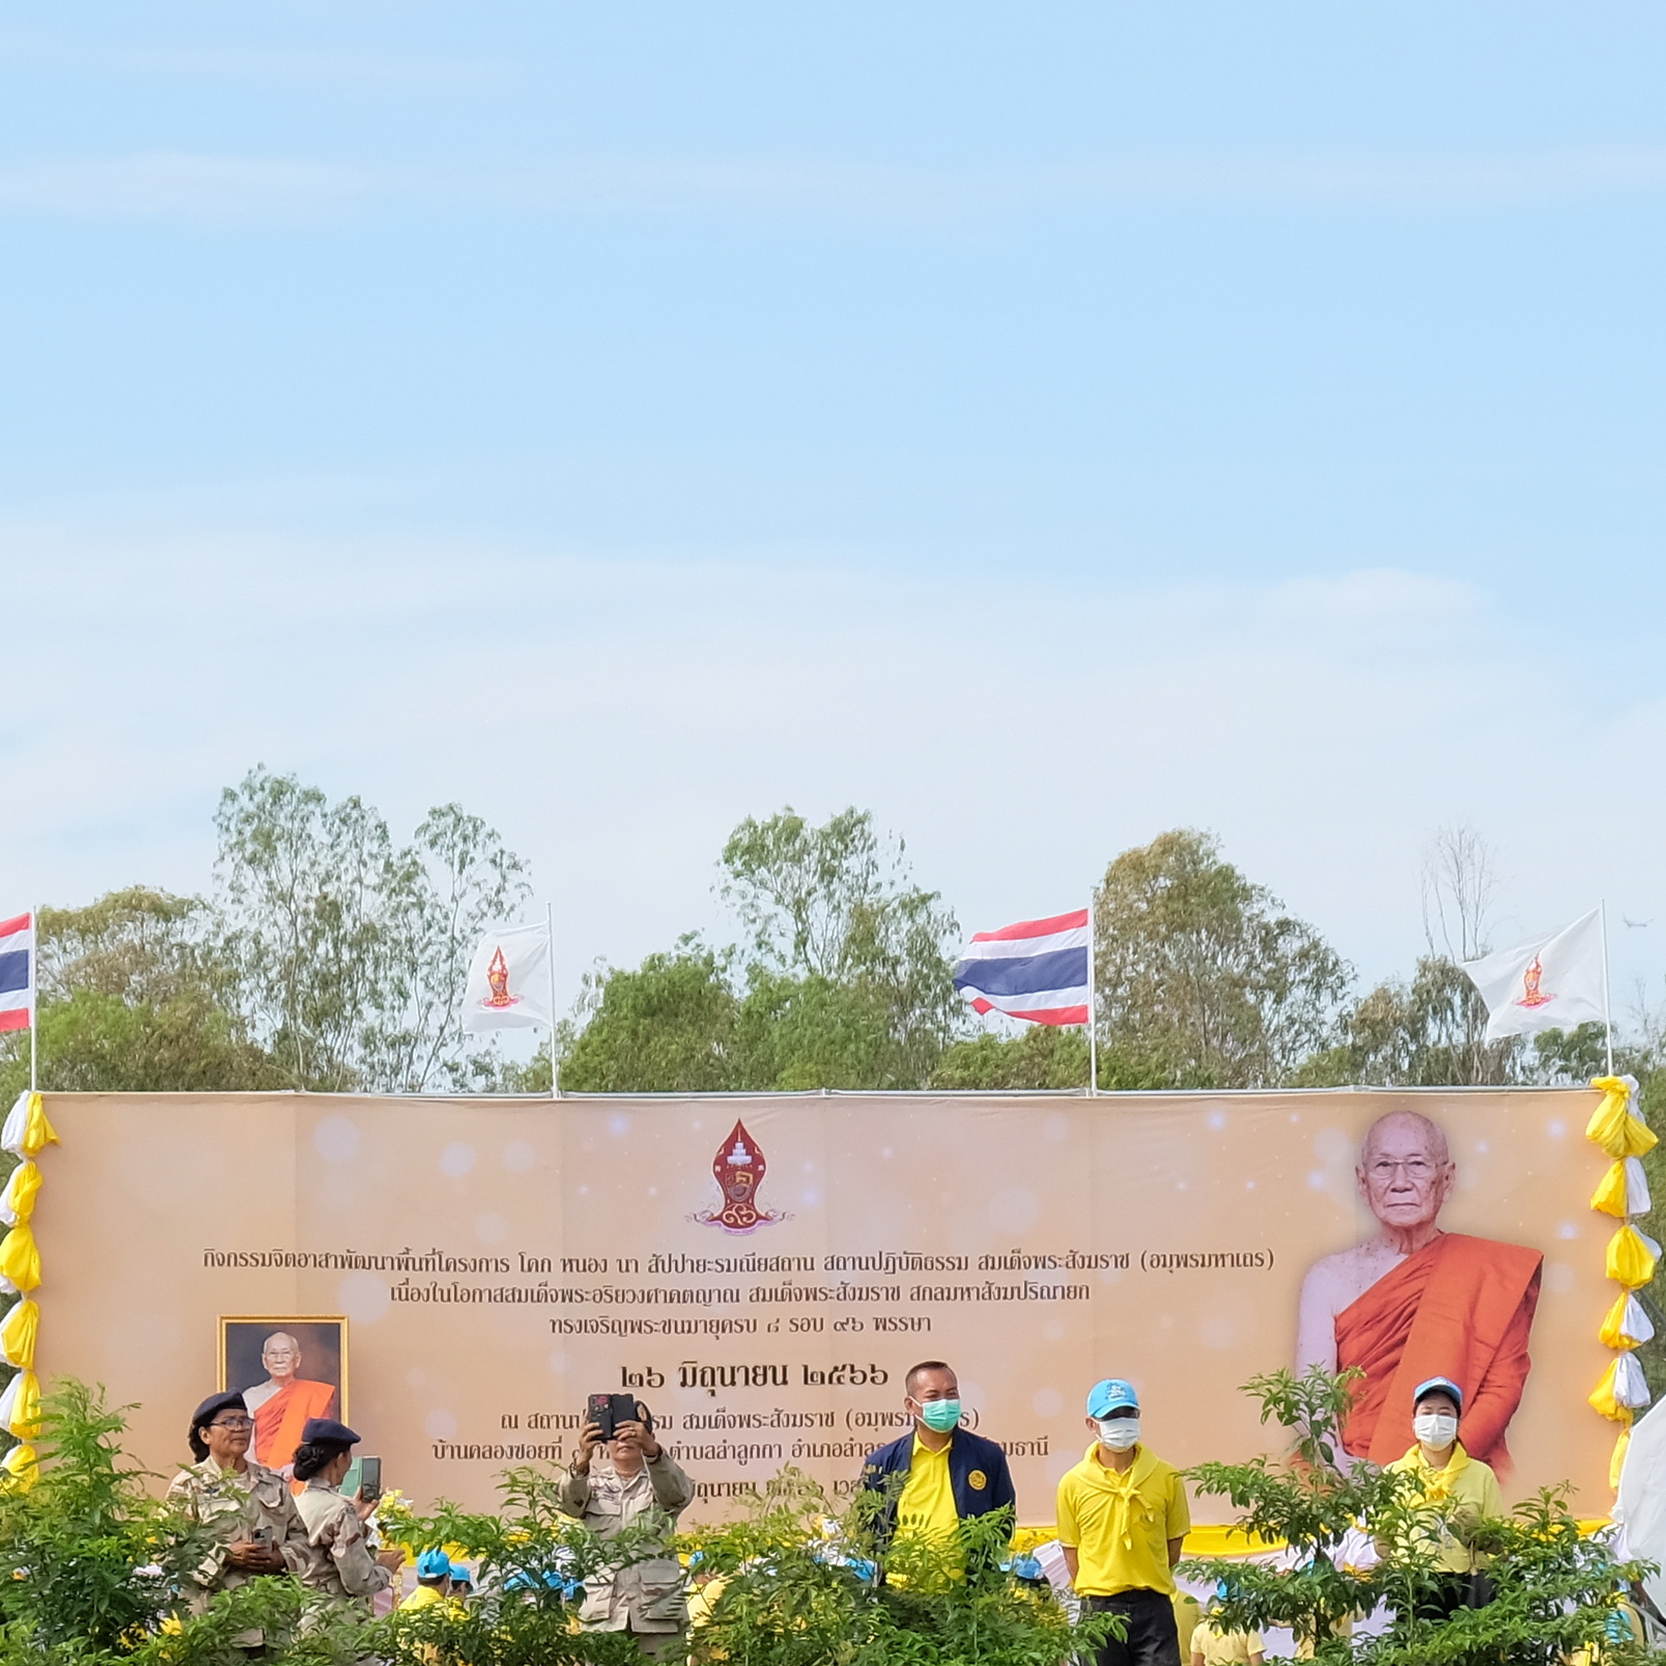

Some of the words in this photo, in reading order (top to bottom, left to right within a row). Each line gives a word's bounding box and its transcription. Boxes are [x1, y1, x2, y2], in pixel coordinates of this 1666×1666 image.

[203, 1246, 510, 1273] กิจกรรมจิตอาสาพัฒนาพื้นที่โครงการ
[518, 1251, 552, 1273] โคก
[559, 1253, 608, 1274] หนอง
[615, 1257, 639, 1274] นา
[823, 1250, 969, 1275] สถานปฏิบัติธรรม
[977, 1247, 1130, 1271] สมเด็จพระสังฆราช
[748, 1279, 901, 1303] สมเด็จพระสังฆราช
[549, 1315, 757, 1341] ทรงเจริญพระชนมายุครบ
[788, 1316, 824, 1333] รอบ
[833, 1315, 864, 1332] ๙๖
[872, 1315, 932, 1332] พรรษา
[620, 1365, 665, 1388] ๒๖
[677, 1360, 789, 1398] มิถุนายน
[801, 1362, 889, 1386] ๒๕๖๖
[501, 1413, 519, 1430] ณ
[682, 1406, 835, 1430] สมเด็จพระสังฆราช
[431, 1435, 563, 1461] บ้านคลองซอยที่
